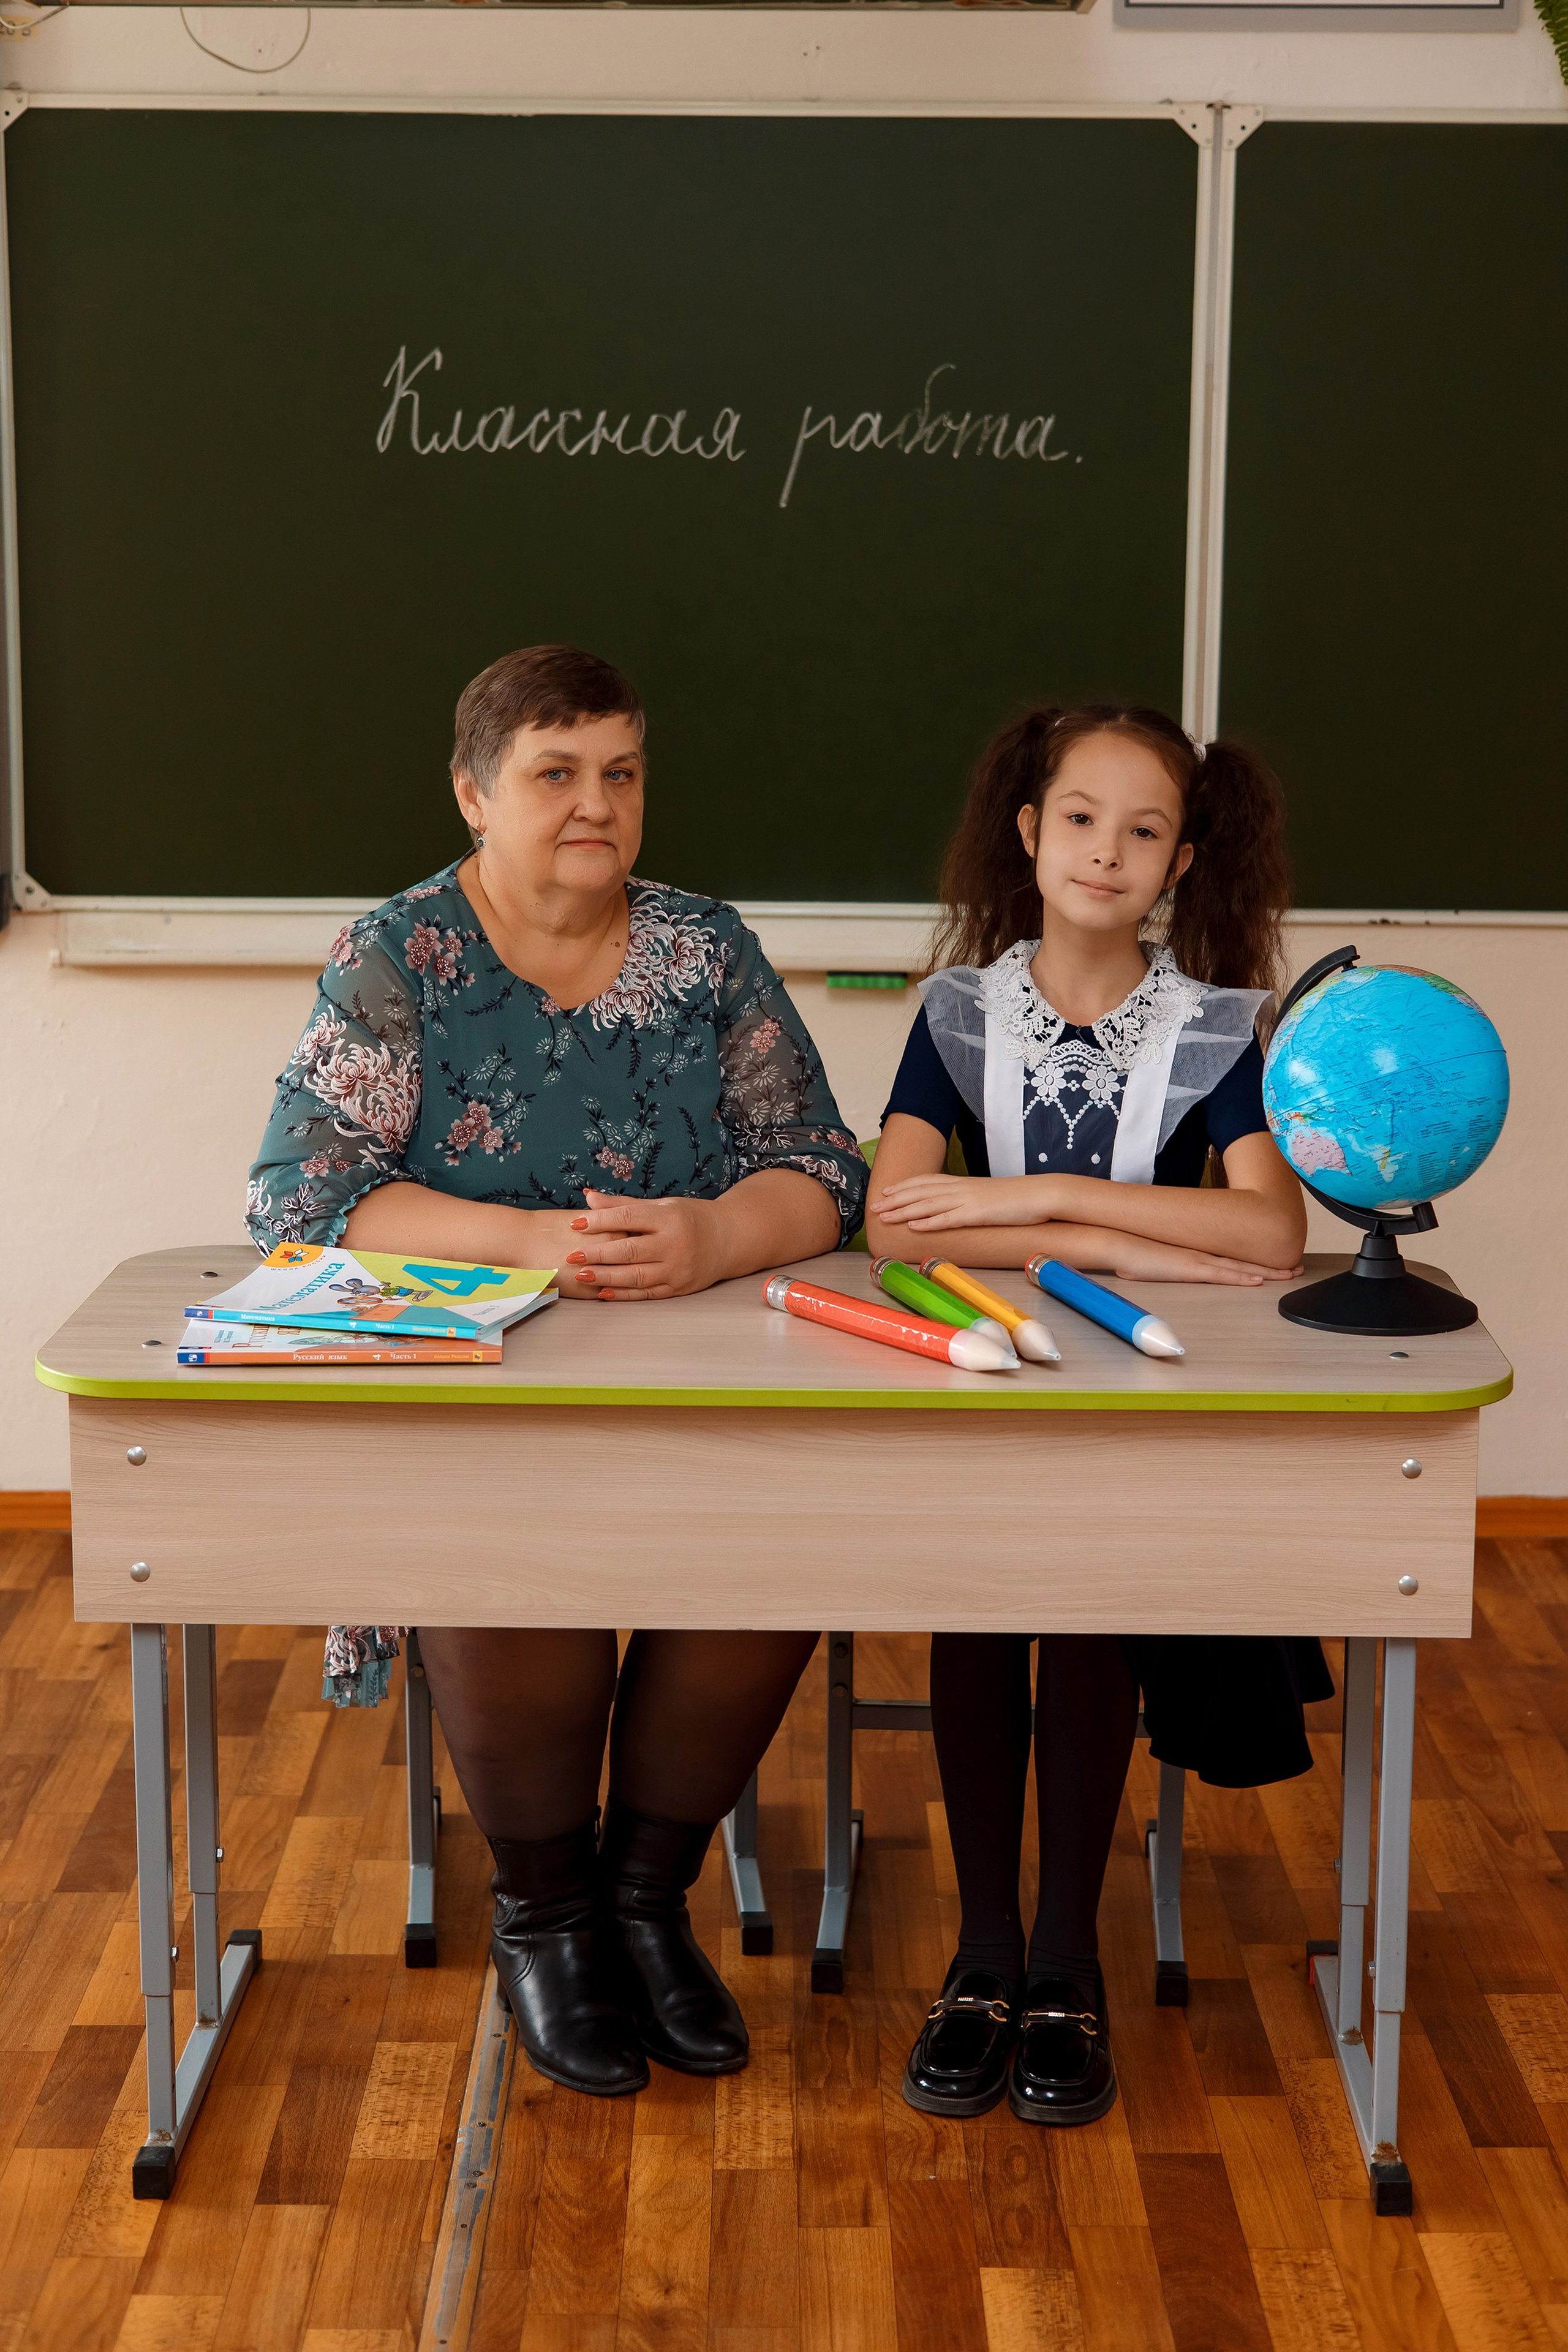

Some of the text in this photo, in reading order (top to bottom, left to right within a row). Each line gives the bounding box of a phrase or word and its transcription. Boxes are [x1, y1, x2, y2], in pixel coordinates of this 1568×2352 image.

[377, 345, 1083, 508] Классная работа.
[303, 1255, 326, 1268] РОССИИ
[252, 1262, 345, 1312] Математика
[402, 1264, 511, 1296] 4
[232, 1324, 272, 1348] Русски
